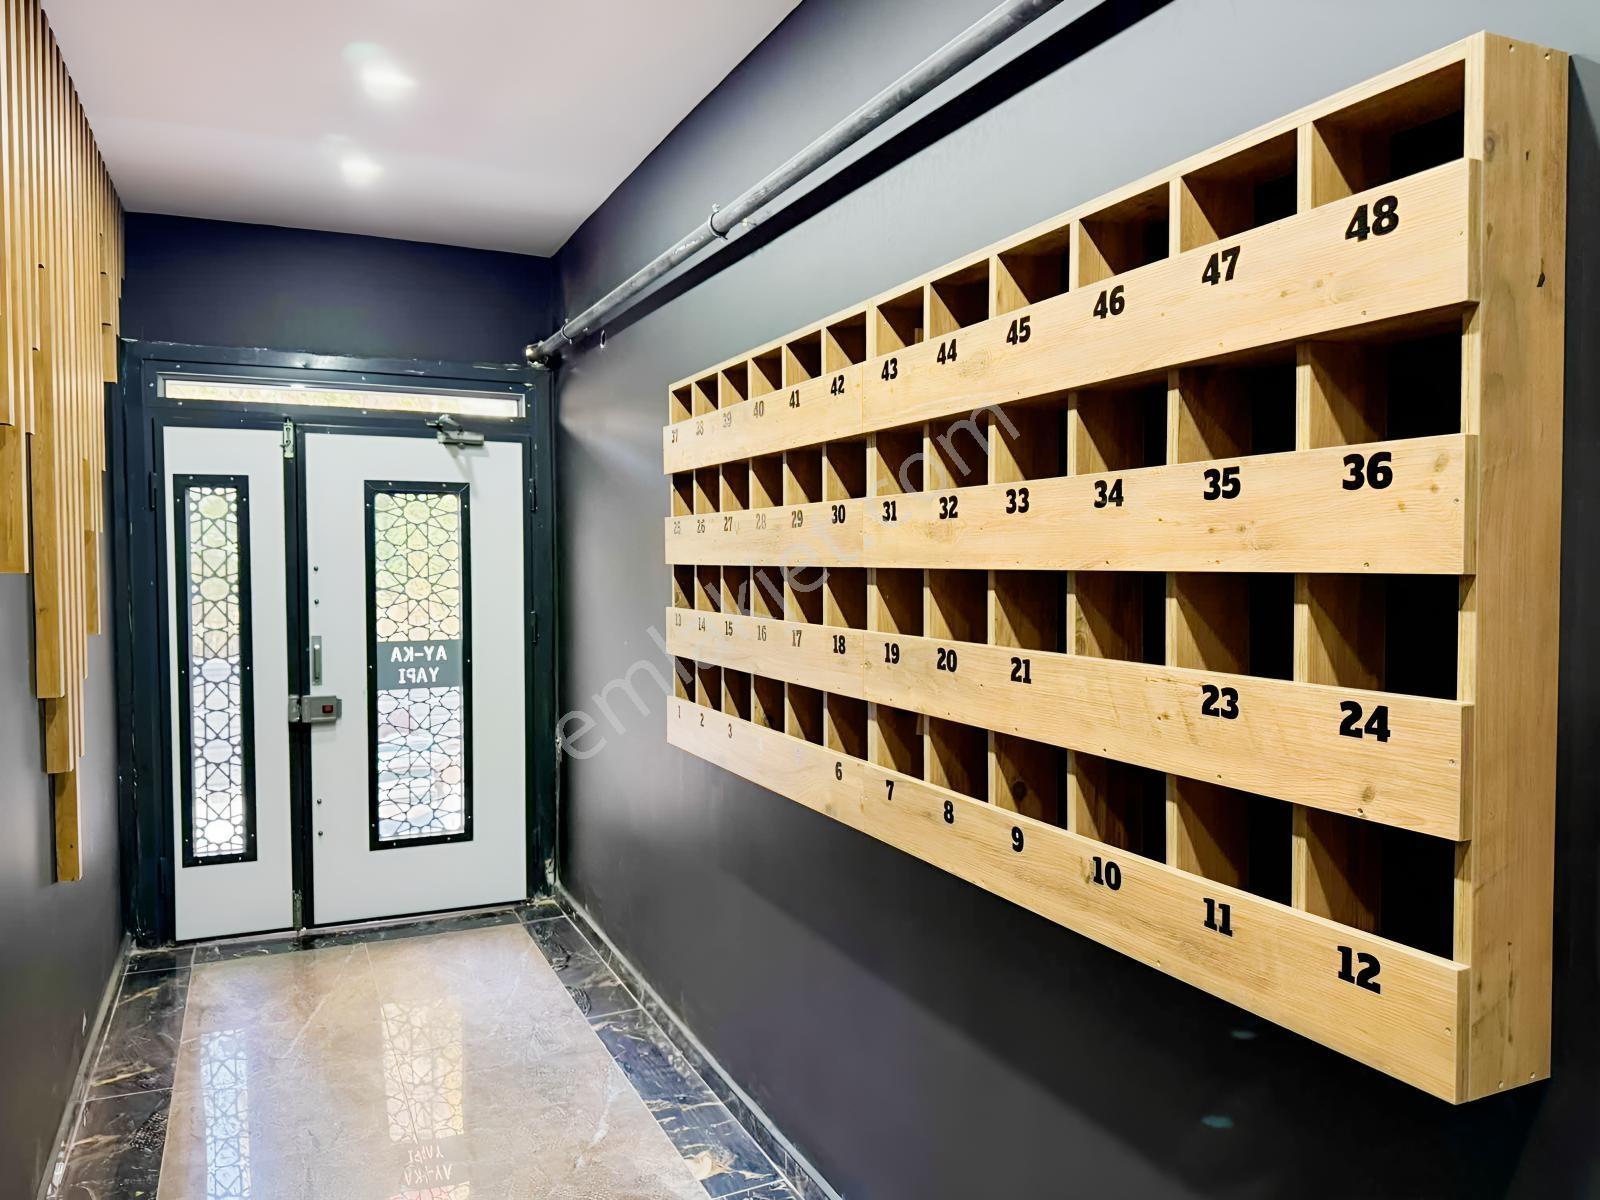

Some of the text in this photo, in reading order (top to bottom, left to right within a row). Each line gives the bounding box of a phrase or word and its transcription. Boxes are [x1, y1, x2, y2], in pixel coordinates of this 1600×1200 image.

[723, 411, 732, 428] 39
[753, 400, 765, 418] 40
[789, 389, 801, 409] 41
[831, 374, 845, 396] 42
[881, 357, 898, 382] 43
[937, 339, 957, 364] 44
[1007, 316, 1030, 345] 45
[1093, 285, 1124, 319] 46
[1202, 246, 1240, 285] 47
[1345, 196, 1399, 241] 48
[696, 519, 706, 533] 26
[723, 516, 733, 532] 27
[755, 513, 767, 530] 28
[791, 510, 803, 528] 29
[832, 504, 846, 524] 30
[883, 501, 897, 521] 31
[940, 496, 958, 519] 32
[1006, 488, 1029, 514] 33
[1094, 479, 1123, 508] 34
[1204, 466, 1240, 500] 35
[1343, 452, 1392, 490] 36
[675, 613, 1390, 742] 13 14 15 16 17 18 19 20 21 23 24
[677, 705, 1380, 994] 1 2 3 6 7 8 9 10 11 12
